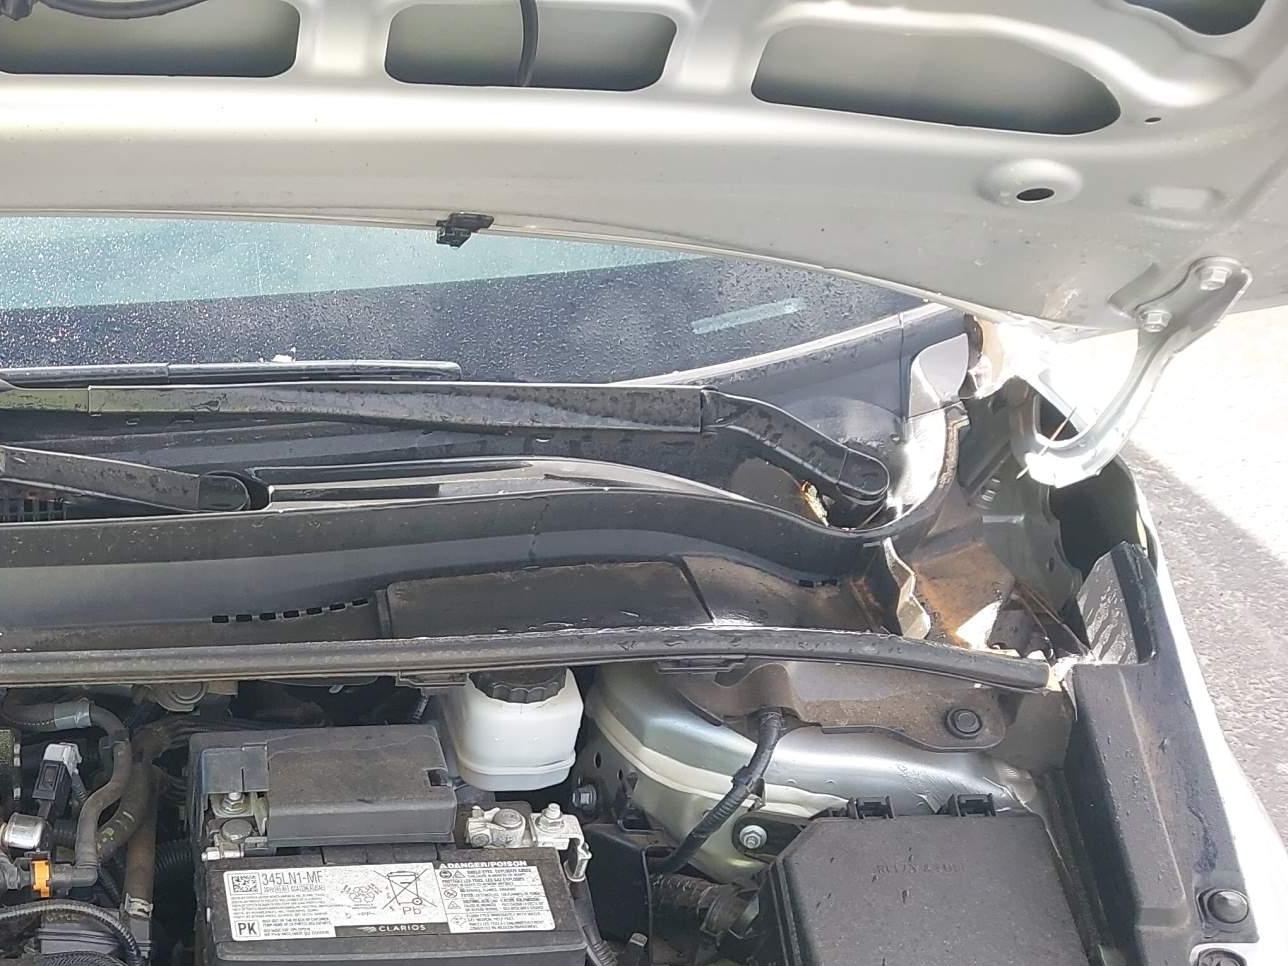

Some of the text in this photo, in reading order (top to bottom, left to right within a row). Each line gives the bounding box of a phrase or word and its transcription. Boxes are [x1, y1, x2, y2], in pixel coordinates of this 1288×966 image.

[447, 861, 528, 869] DANGER/POISON
[261, 870, 322, 885] 345LN1-MF
[402, 906, 422, 915] Pb
[237, 922, 257, 936] PK
[378, 924, 427, 932] CLARIOS
